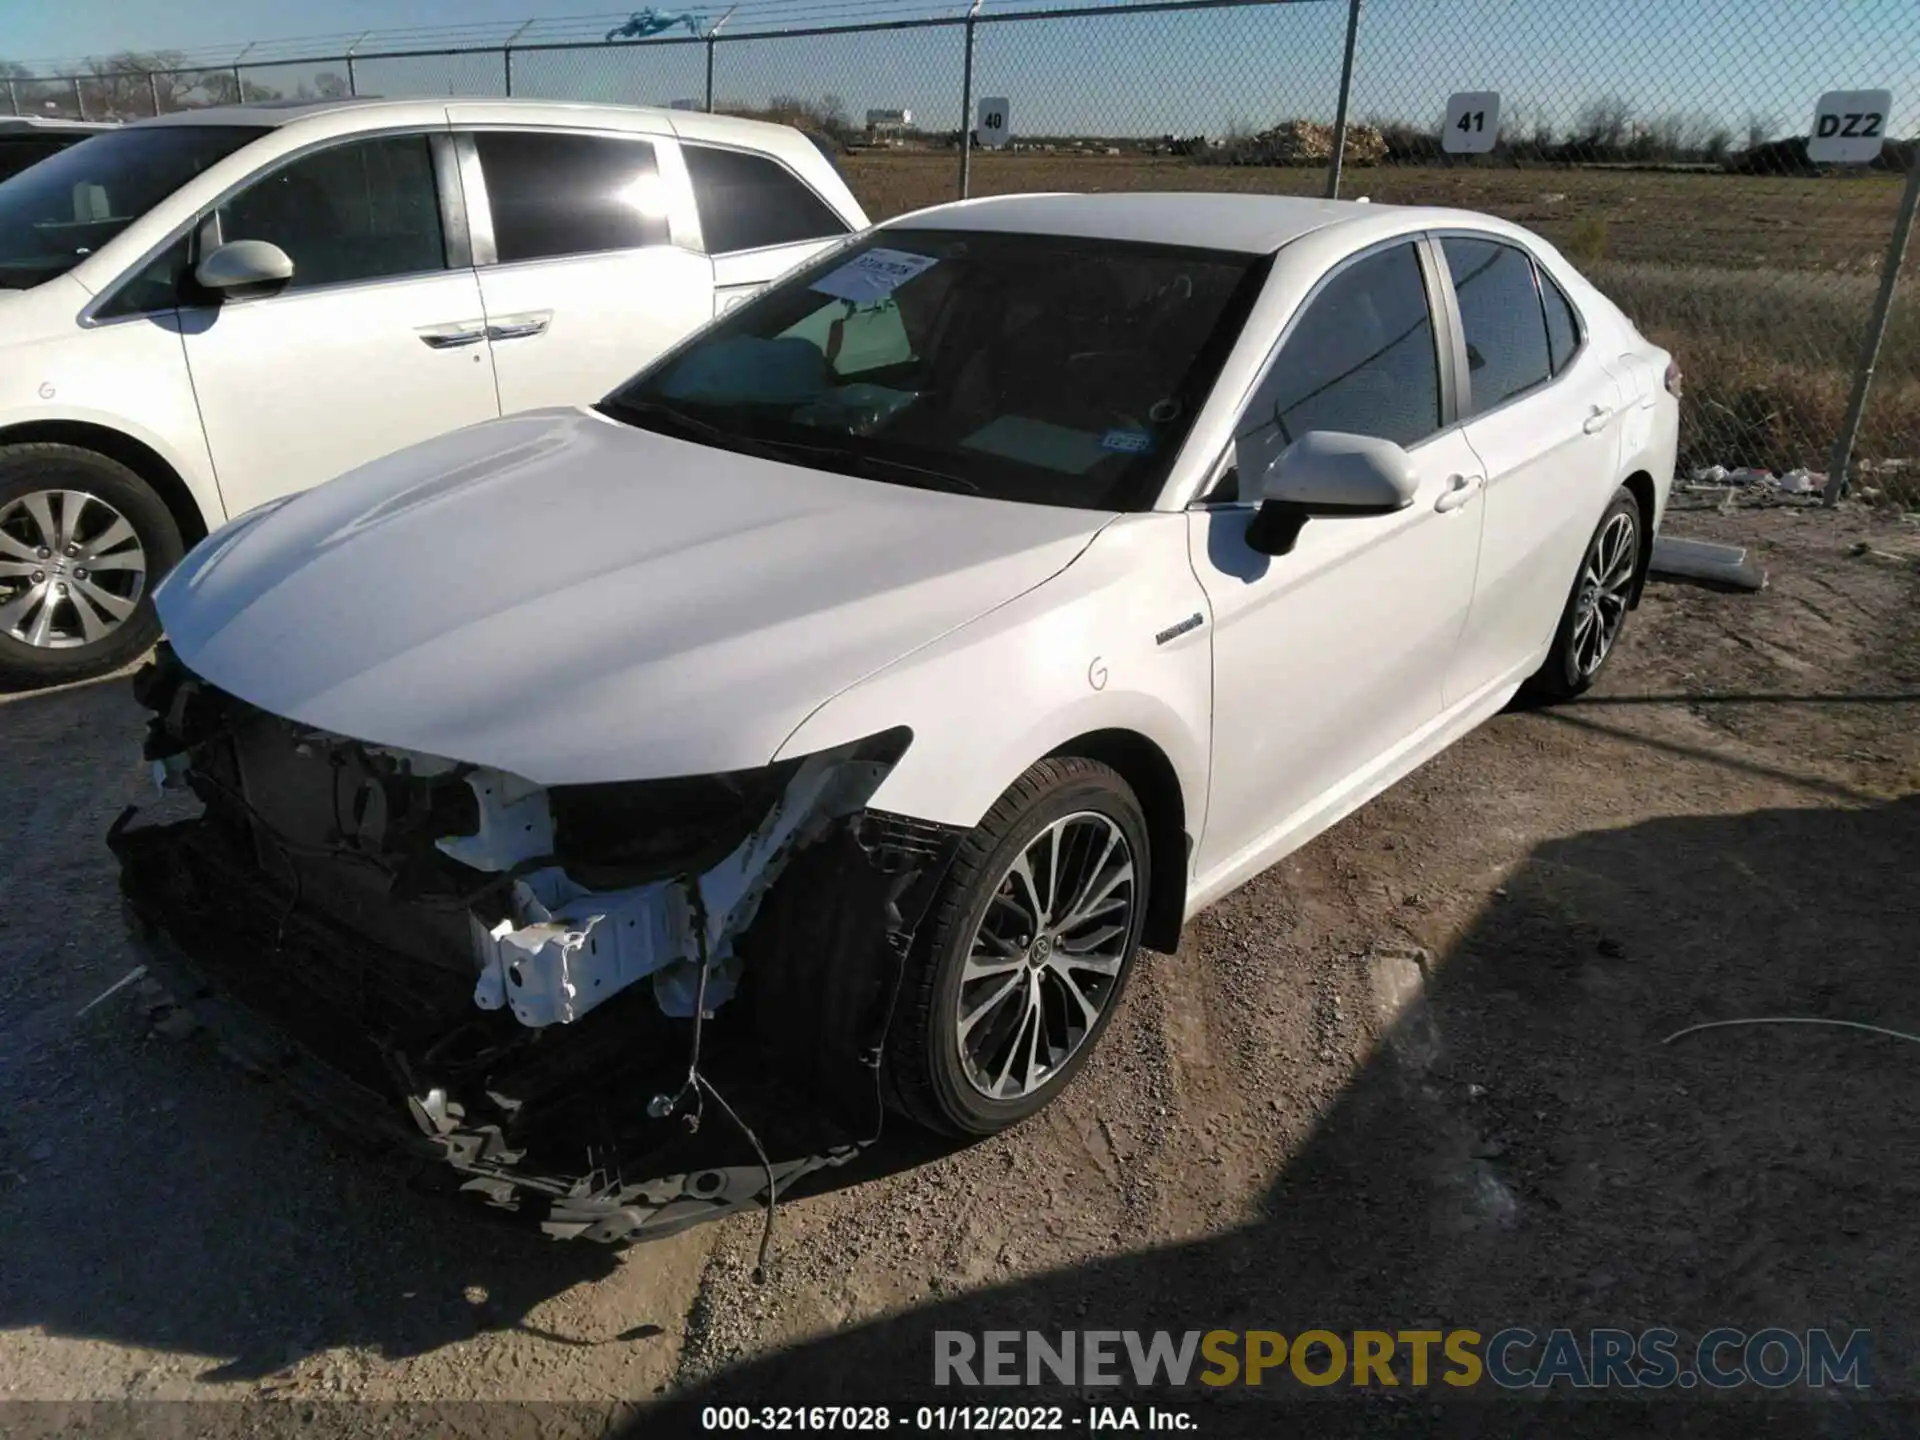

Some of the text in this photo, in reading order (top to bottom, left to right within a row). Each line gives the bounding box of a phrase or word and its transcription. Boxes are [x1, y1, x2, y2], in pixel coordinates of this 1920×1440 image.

[984, 112, 1002, 129] 40
[1456, 111, 1484, 132] 41
[1818, 113, 1882, 137] DZ2
